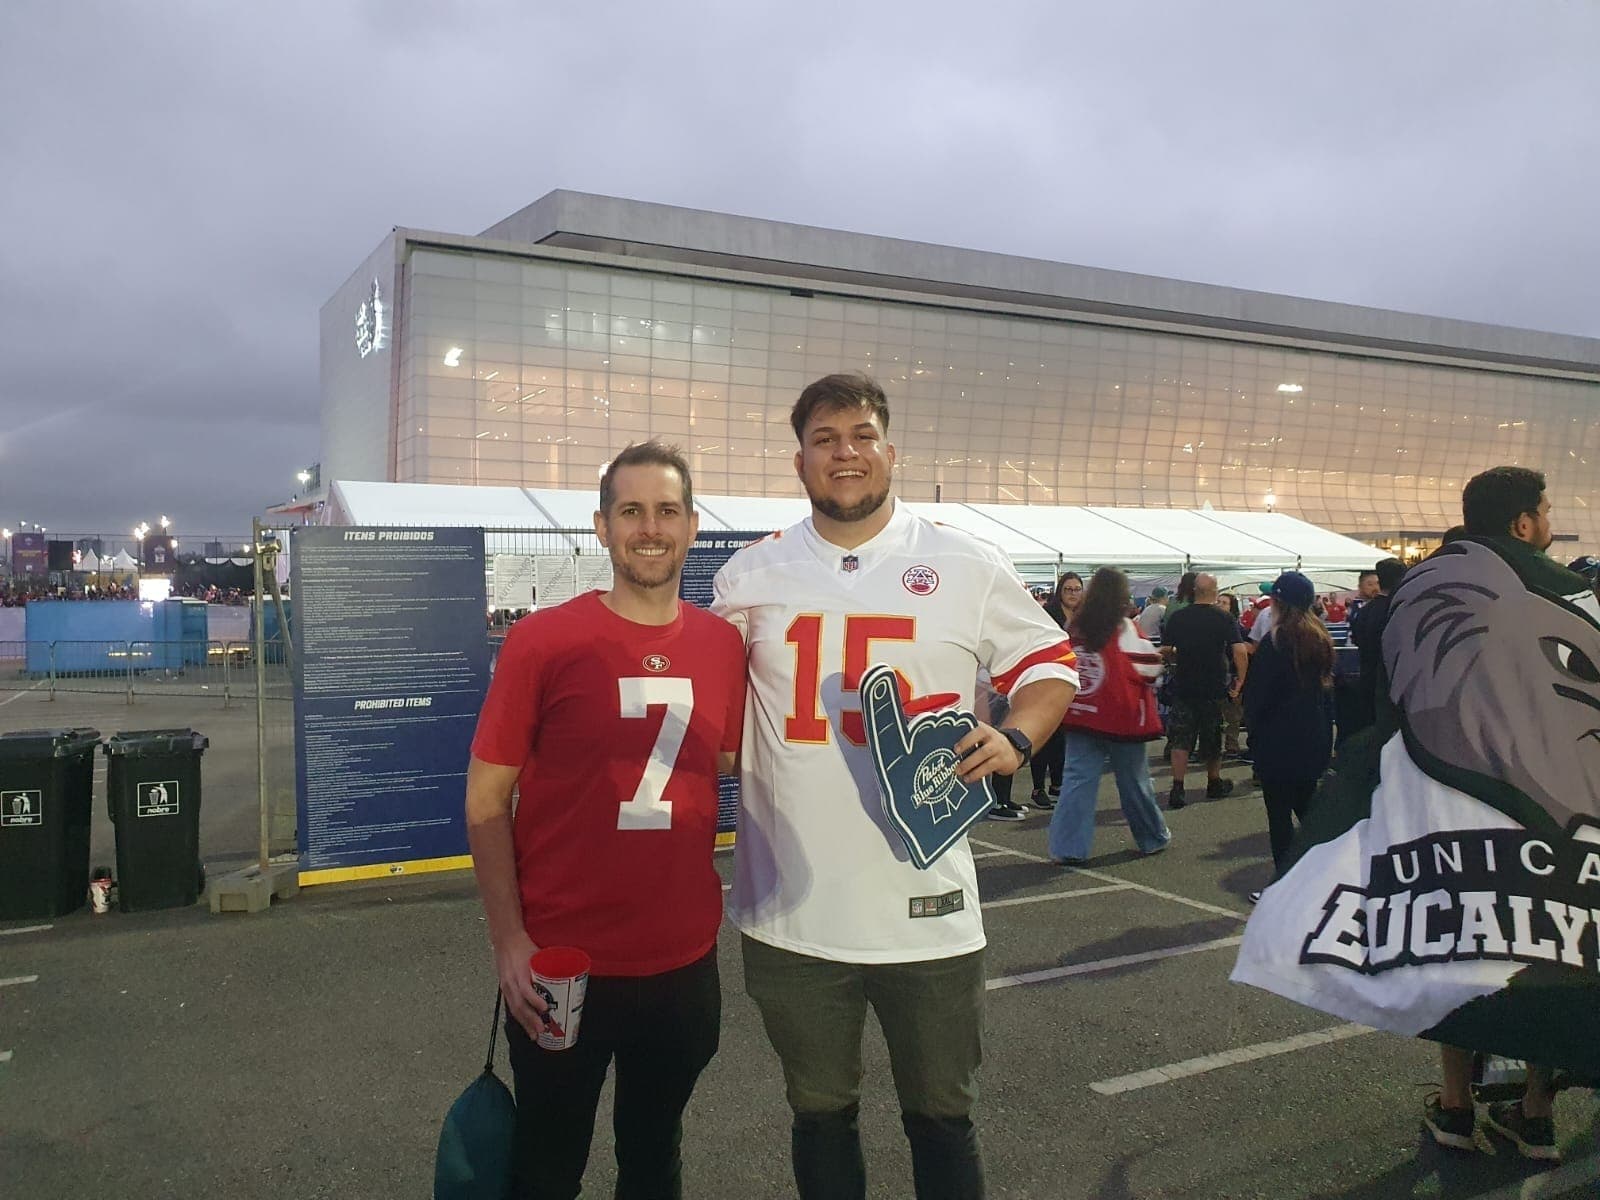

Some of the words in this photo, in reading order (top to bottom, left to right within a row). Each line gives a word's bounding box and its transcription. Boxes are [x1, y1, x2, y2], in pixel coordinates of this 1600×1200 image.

[343, 531, 377, 541] ITENS
[378, 531, 434, 541] PROIBIDOS
[692, 540, 713, 549] DIGO
[714, 540, 727, 549] DE
[727, 540, 752, 549] COND
[784, 613, 916, 746] 15
[354, 698, 404, 710] PROHIBITED
[405, 697, 432, 708] ITEMS
[616, 677, 695, 830] 7
[922, 755, 946, 786] Pabst
[914, 784, 935, 806] Blue
[1305, 887, 1600, 972] EUCALY
